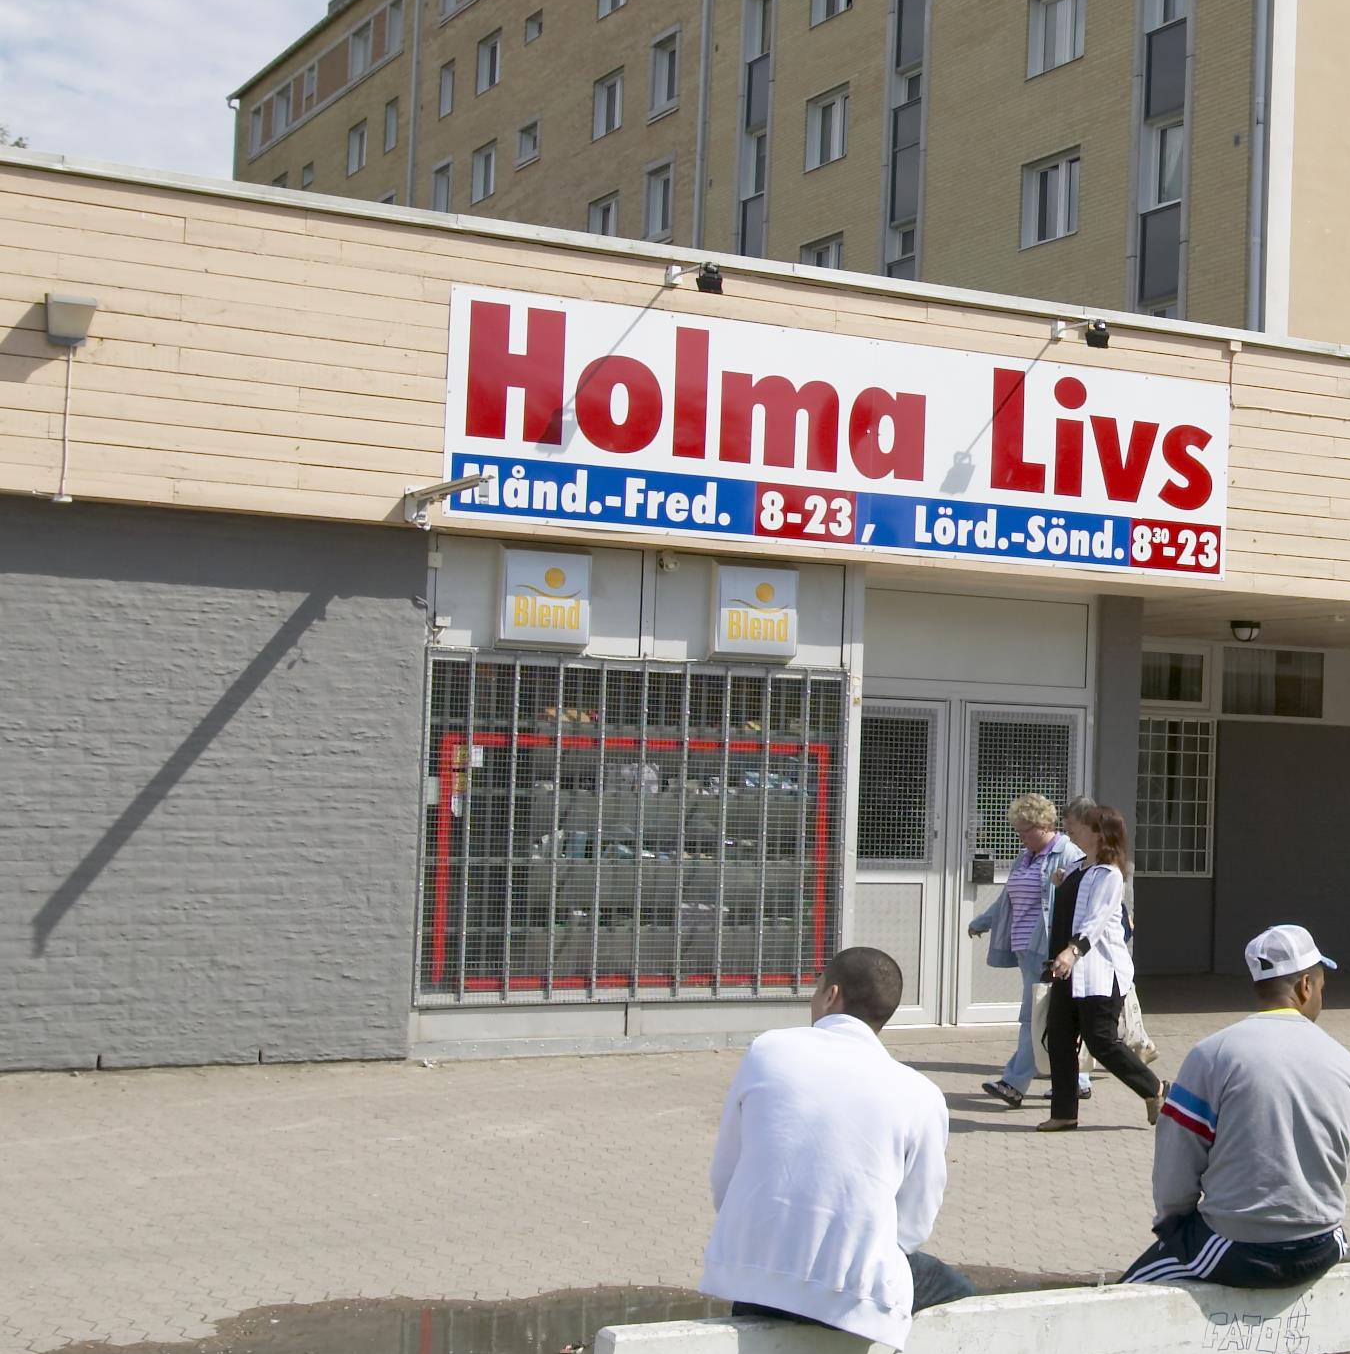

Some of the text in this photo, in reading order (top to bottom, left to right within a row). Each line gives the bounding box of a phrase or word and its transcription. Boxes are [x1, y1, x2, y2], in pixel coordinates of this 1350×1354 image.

[465, 301, 1214, 511] Holma Livs
[513, 596, 581, 631] Blend
[727, 609, 789, 643] Blend
